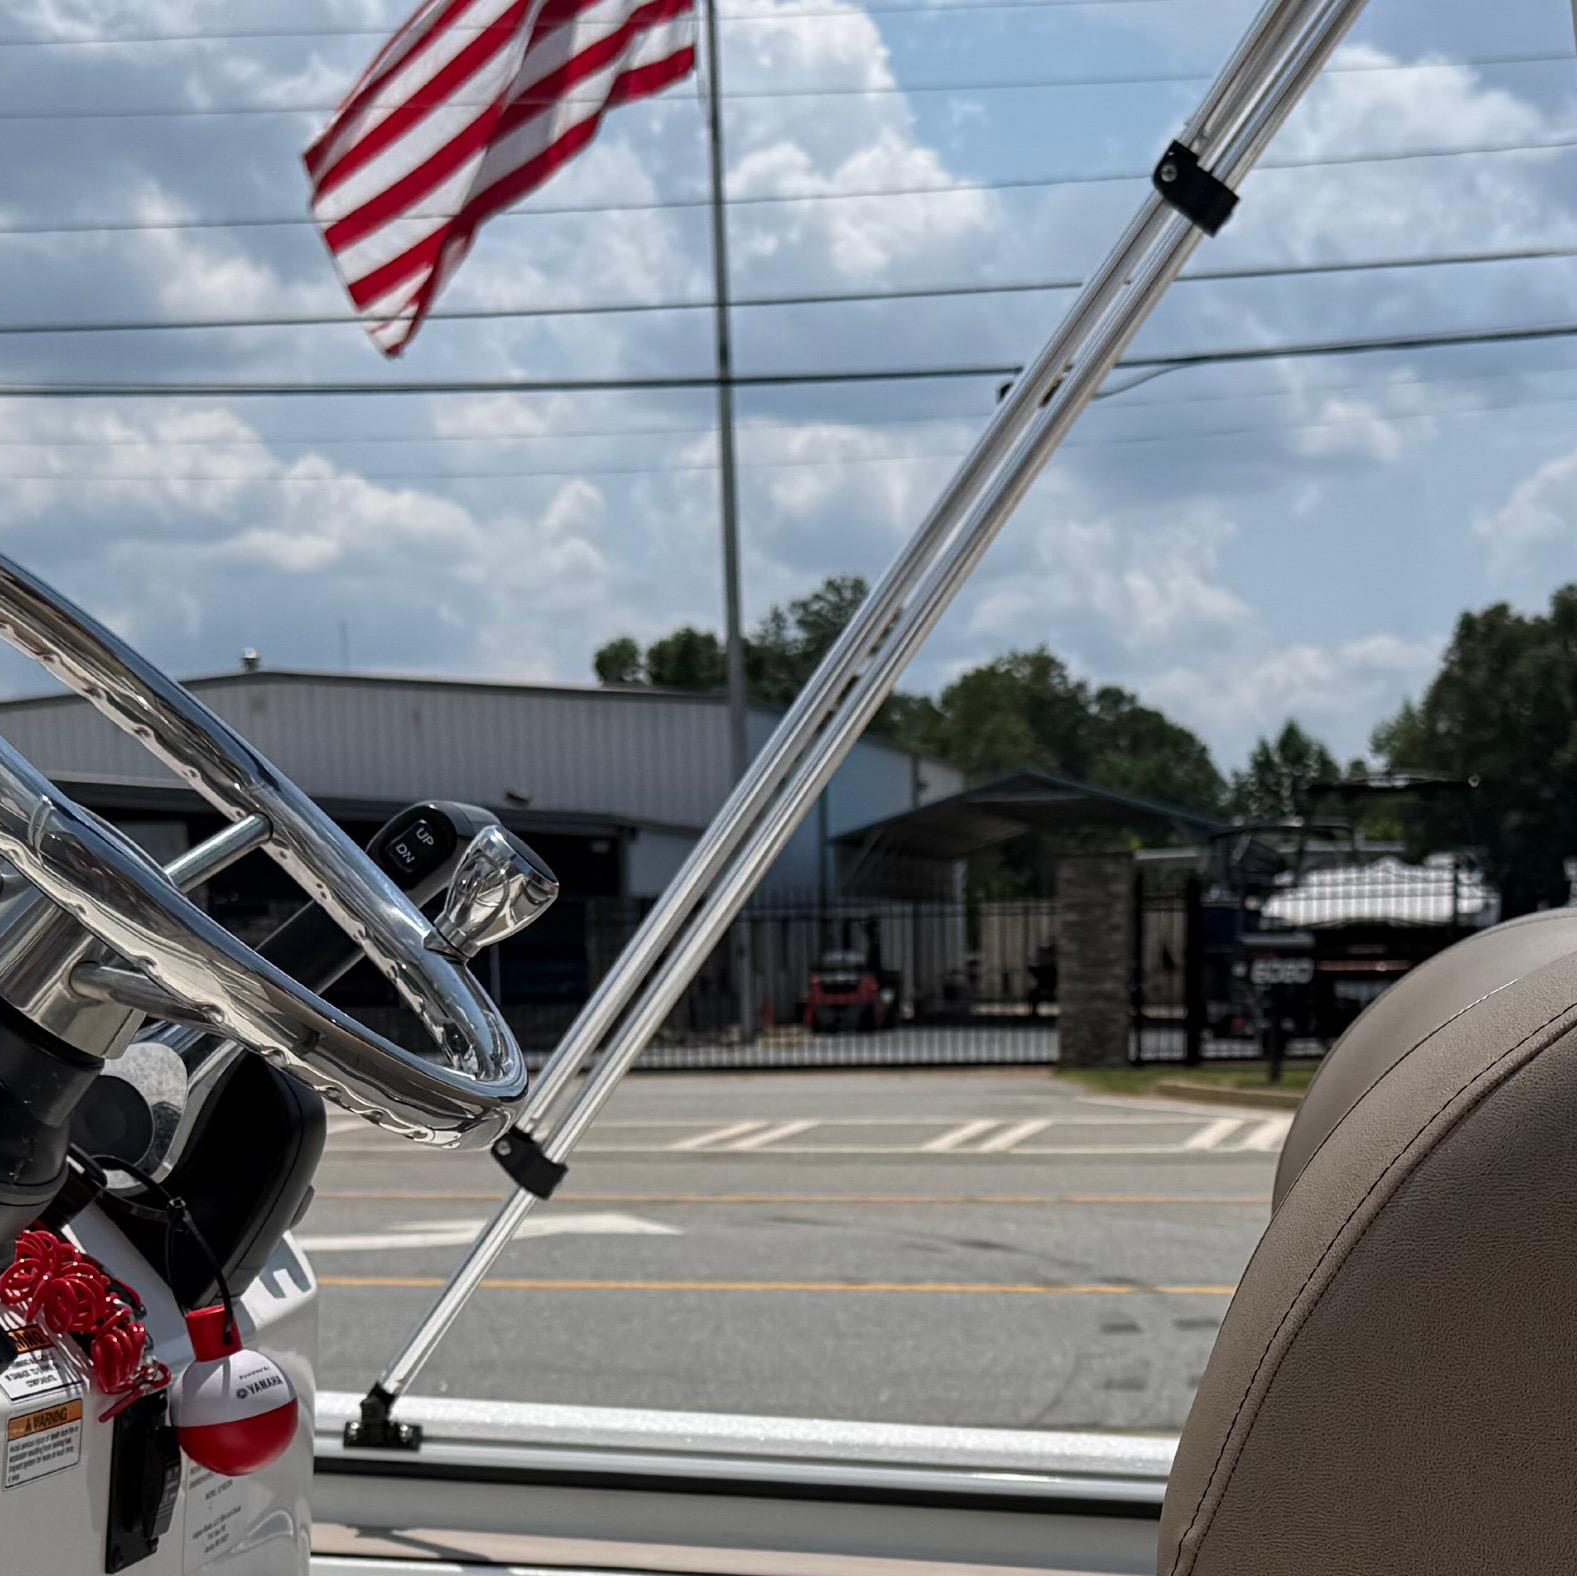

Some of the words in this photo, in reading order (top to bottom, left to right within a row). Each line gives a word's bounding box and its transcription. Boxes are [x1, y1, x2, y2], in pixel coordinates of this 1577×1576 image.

[415, 827, 434, 846] UP
[395, 843, 416, 864] DN
[246, 1375, 283, 1394] YAMAHA
[33, 1407, 67, 1430] WARNING
